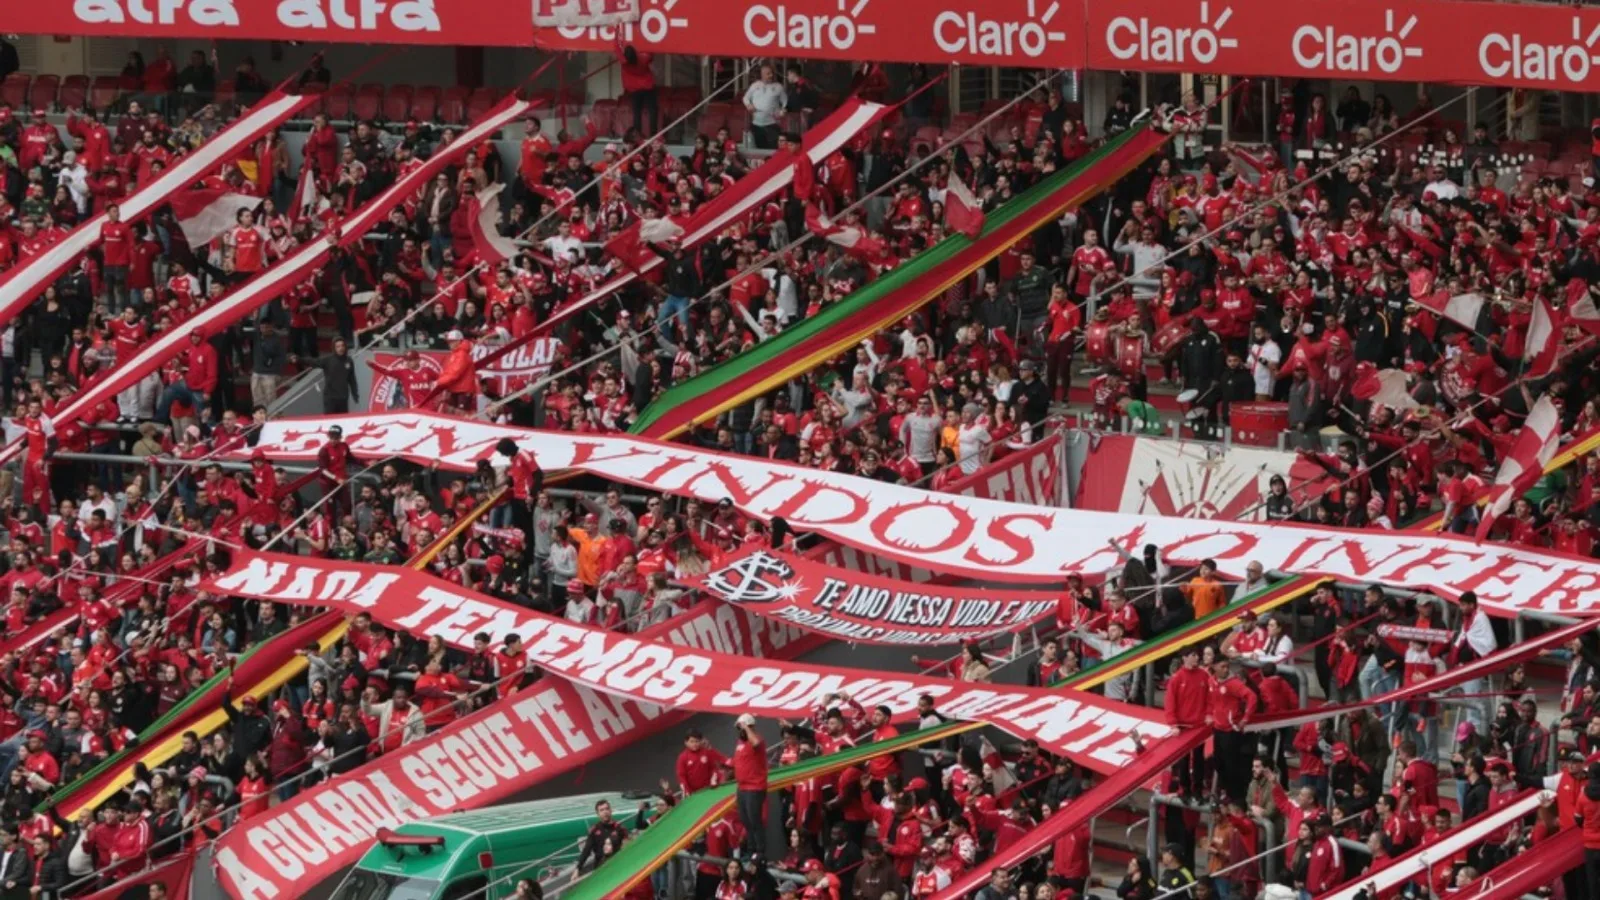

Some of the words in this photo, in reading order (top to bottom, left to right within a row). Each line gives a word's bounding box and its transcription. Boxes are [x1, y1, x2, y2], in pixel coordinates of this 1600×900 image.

[276, 0, 442, 32] alfa
[743, 4, 856, 49] Claro
[933, 11, 1047, 57] Claro
[1106, 17, 1219, 64] Claro
[1292, 25, 1404, 73] Claro
[1478, 33, 1590, 82] Claro
[569, 441, 1055, 568] VINDOS
[1277, 534, 1600, 611] INFER
[812, 577, 848, 609] TE
[836, 584, 889, 619] AMO
[885, 592, 953, 627] NESSA
[949, 598, 1000, 627] VIDA
[994, 600, 1020, 625] E
[214, 557, 401, 608] NADA
[712, 666, 953, 715] SOMOS
[992, 694, 1172, 767] INTE
[518, 688, 592, 759] TE
[402, 721, 545, 809] SEGUE
[247, 769, 430, 881] GUARDA
[218, 847, 279, 900] A
